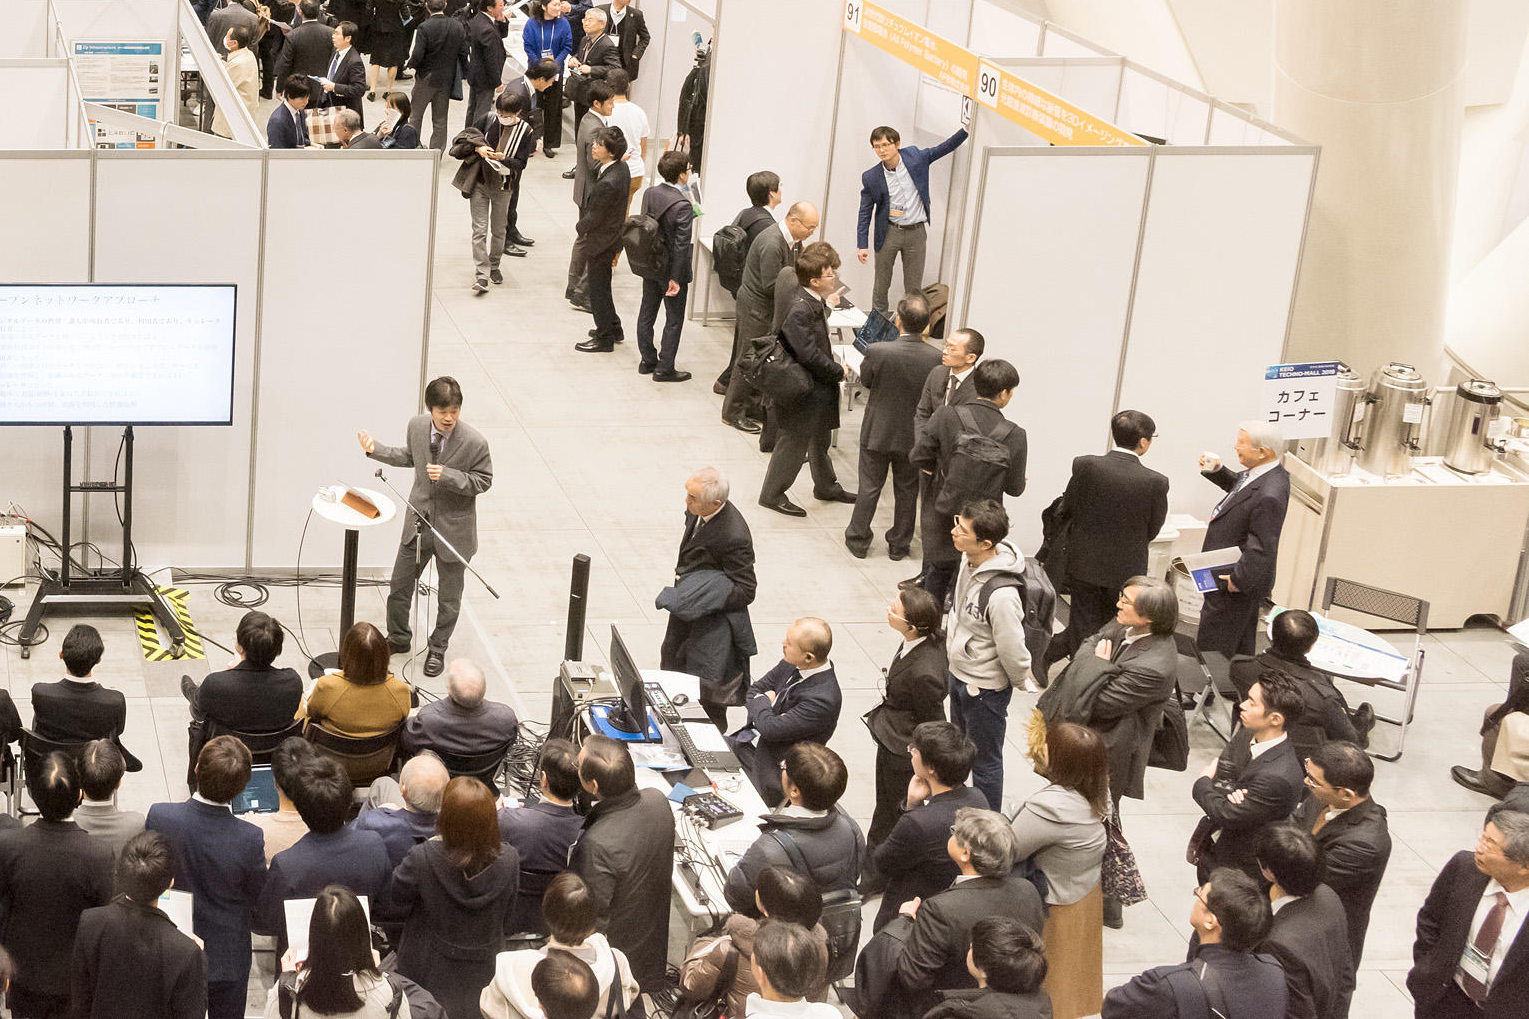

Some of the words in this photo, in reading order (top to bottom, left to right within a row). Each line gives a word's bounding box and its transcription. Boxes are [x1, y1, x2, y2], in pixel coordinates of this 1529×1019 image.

[846, 2, 860, 25] 91
[980, 72, 997, 98] 90
[1279, 369, 1321, 378] TECHNO-MALL
[1277, 390, 1320, 404] カフェ
[1268, 408, 1326, 423] コーナー
